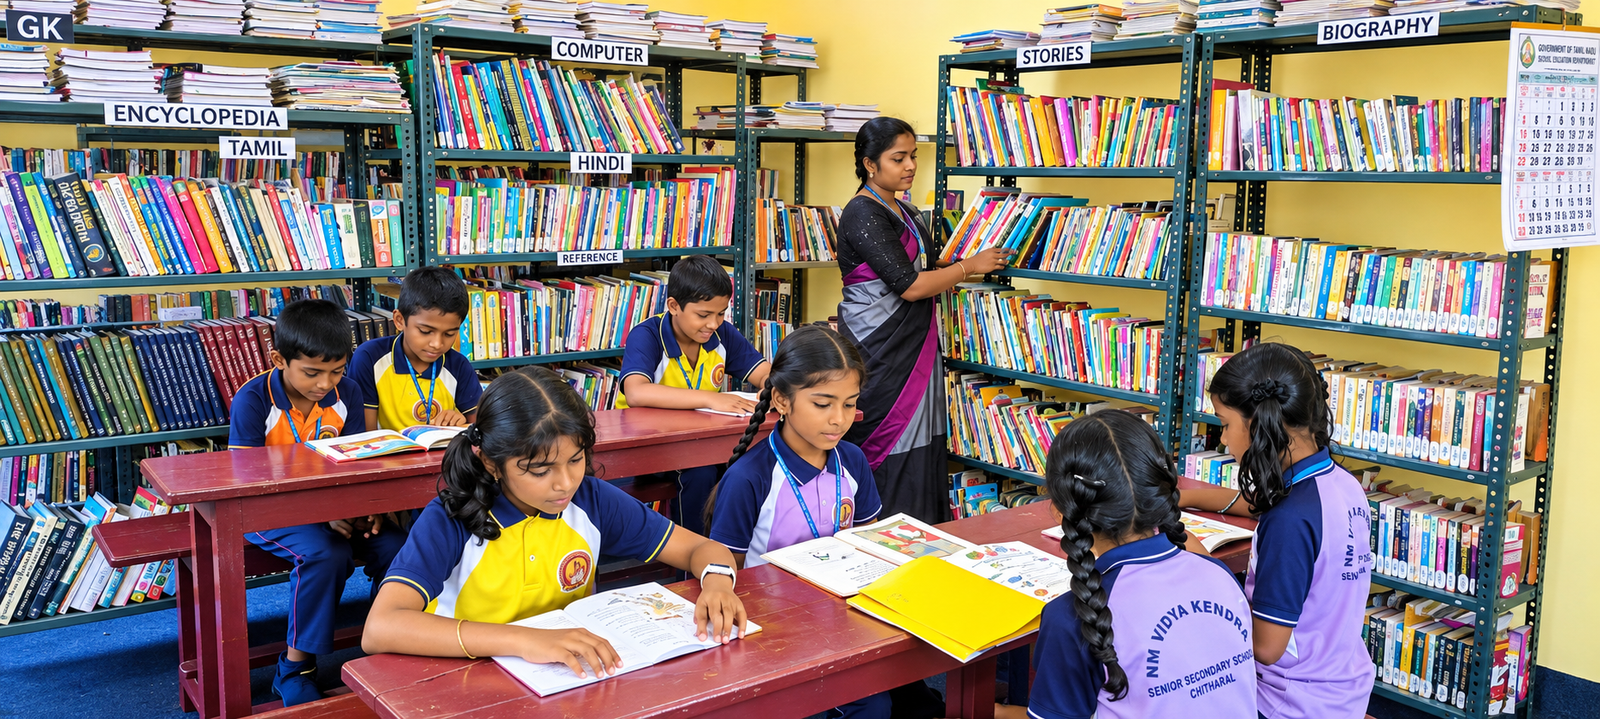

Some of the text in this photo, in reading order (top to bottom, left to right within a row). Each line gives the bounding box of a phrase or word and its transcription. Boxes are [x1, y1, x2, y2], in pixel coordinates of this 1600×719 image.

[17, 15, 62, 40] GK
[1323, 16, 1434, 41] BIOGRAPHY
[556, 41, 643, 63] COMPUTER
[1023, 45, 1084, 65] STORIES
[114, 104, 280, 127] ENCYCLOPEDIA
[228, 140, 287, 156] TAMIL
[578, 156, 624, 171] HINDI
[562, 252, 618, 263] REFERENCE
[1344, 545, 1354, 567] NM
[1146, 600, 1248, 678] NM VIDYA KENDRA
[1148, 679, 1183, 698] SENIOR
[1184, 659, 1231, 685] SECONDARY
[1190, 673, 1236, 698] CHITHARAL
